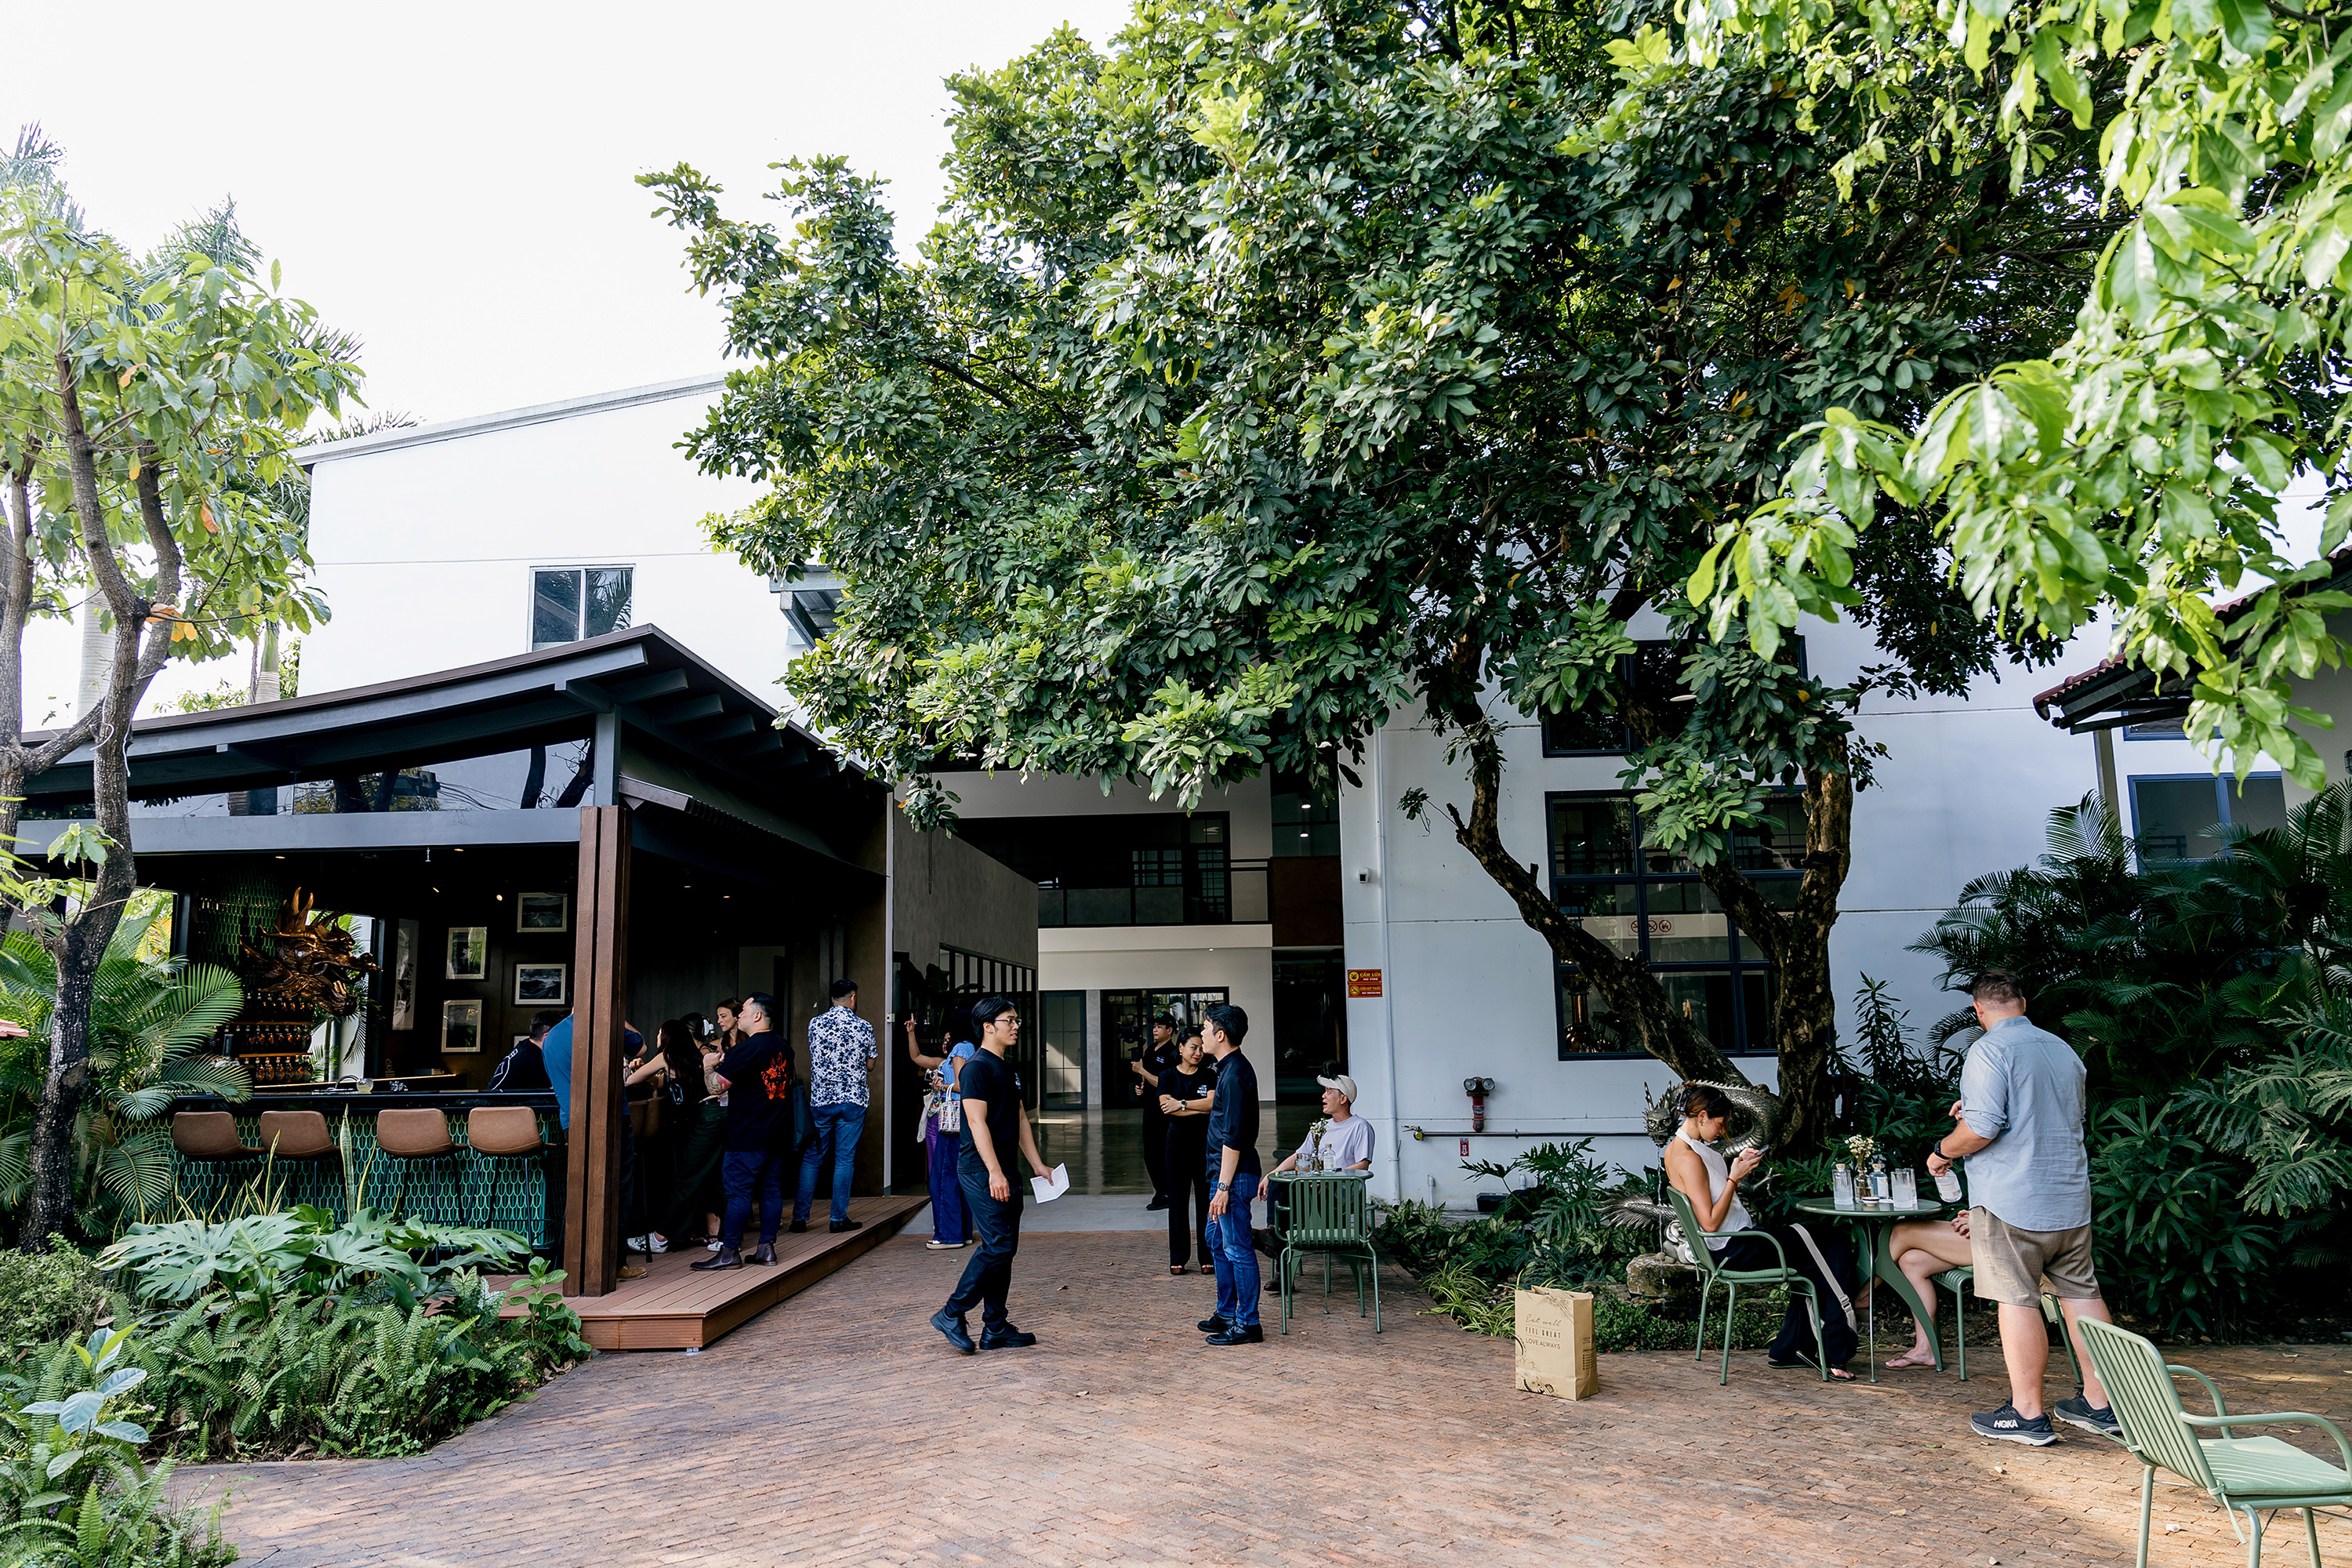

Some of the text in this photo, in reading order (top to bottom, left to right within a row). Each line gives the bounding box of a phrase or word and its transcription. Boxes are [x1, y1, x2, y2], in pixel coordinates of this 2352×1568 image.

[1526, 1313, 1541, 1323] Eat
[1525, 1327, 1561, 1338] FEEL GREAT
[1993, 1419, 2018, 1428] HOKA
